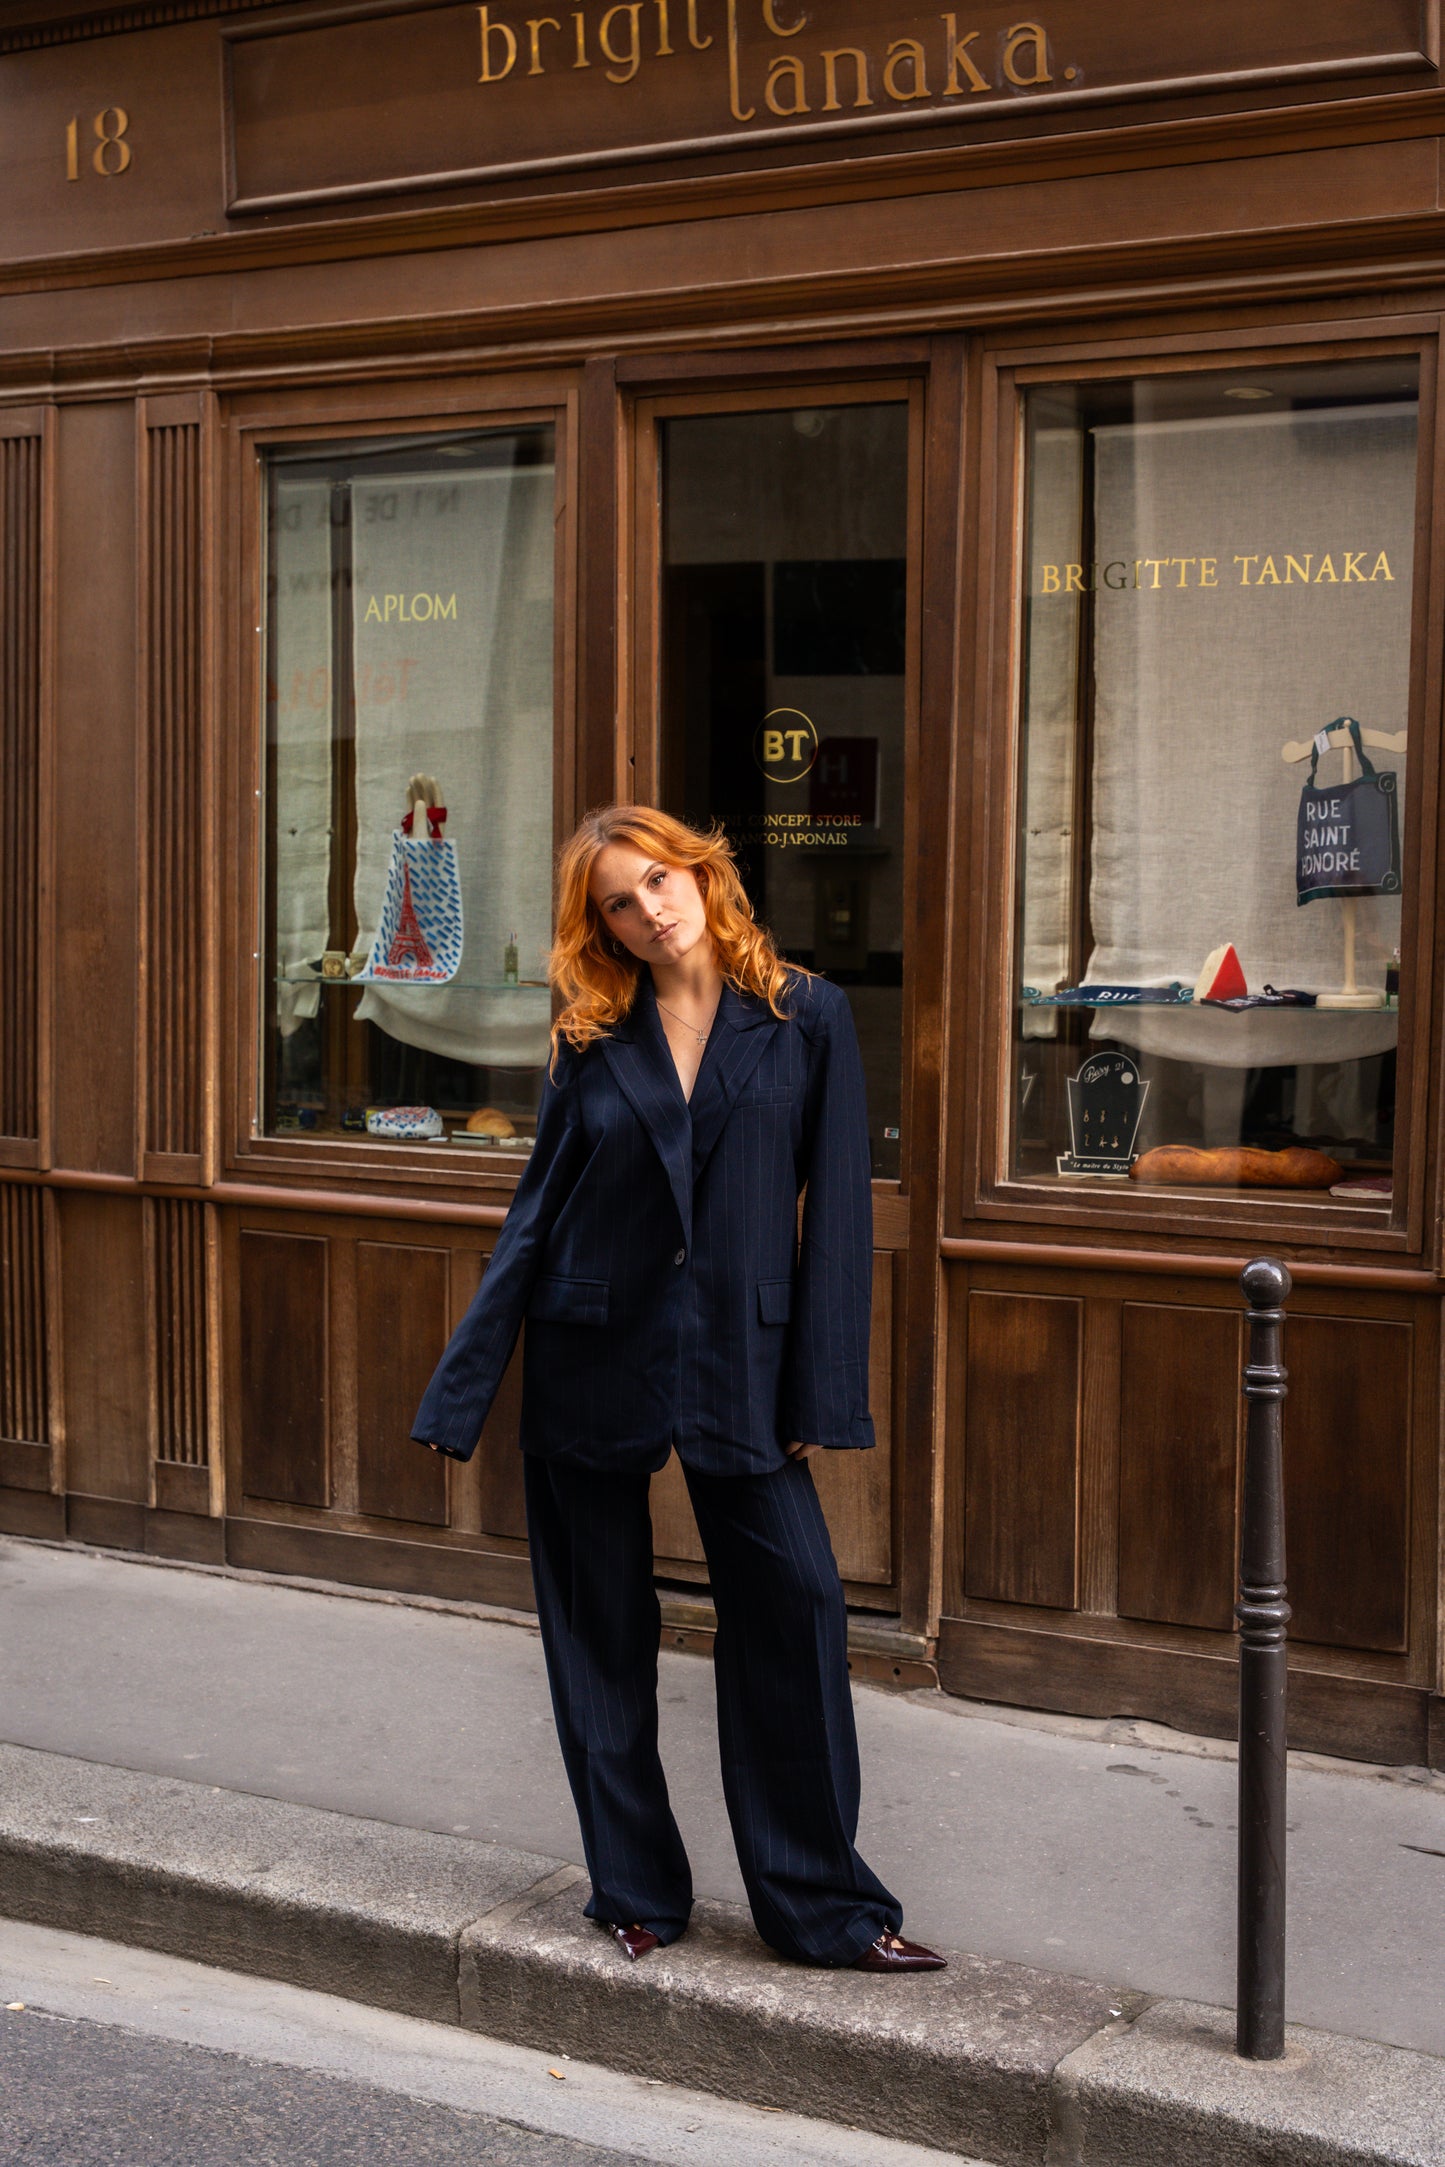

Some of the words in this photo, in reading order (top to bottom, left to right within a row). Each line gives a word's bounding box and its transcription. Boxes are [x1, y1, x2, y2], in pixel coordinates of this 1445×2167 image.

[65, 107, 131, 180] 18
[1041, 557, 1219, 594] BRIGITTE
[1233, 550, 1396, 587] TANAKA
[364, 592, 458, 623] APLOM
[763, 730, 810, 762] BT
[747, 814, 812, 828] CONCEPT
[816, 814, 862, 827] STORE
[1306, 799, 1342, 822] RUE
[1304, 825, 1351, 849] SAINT
[1301, 848, 1361, 876] HONORÉ
